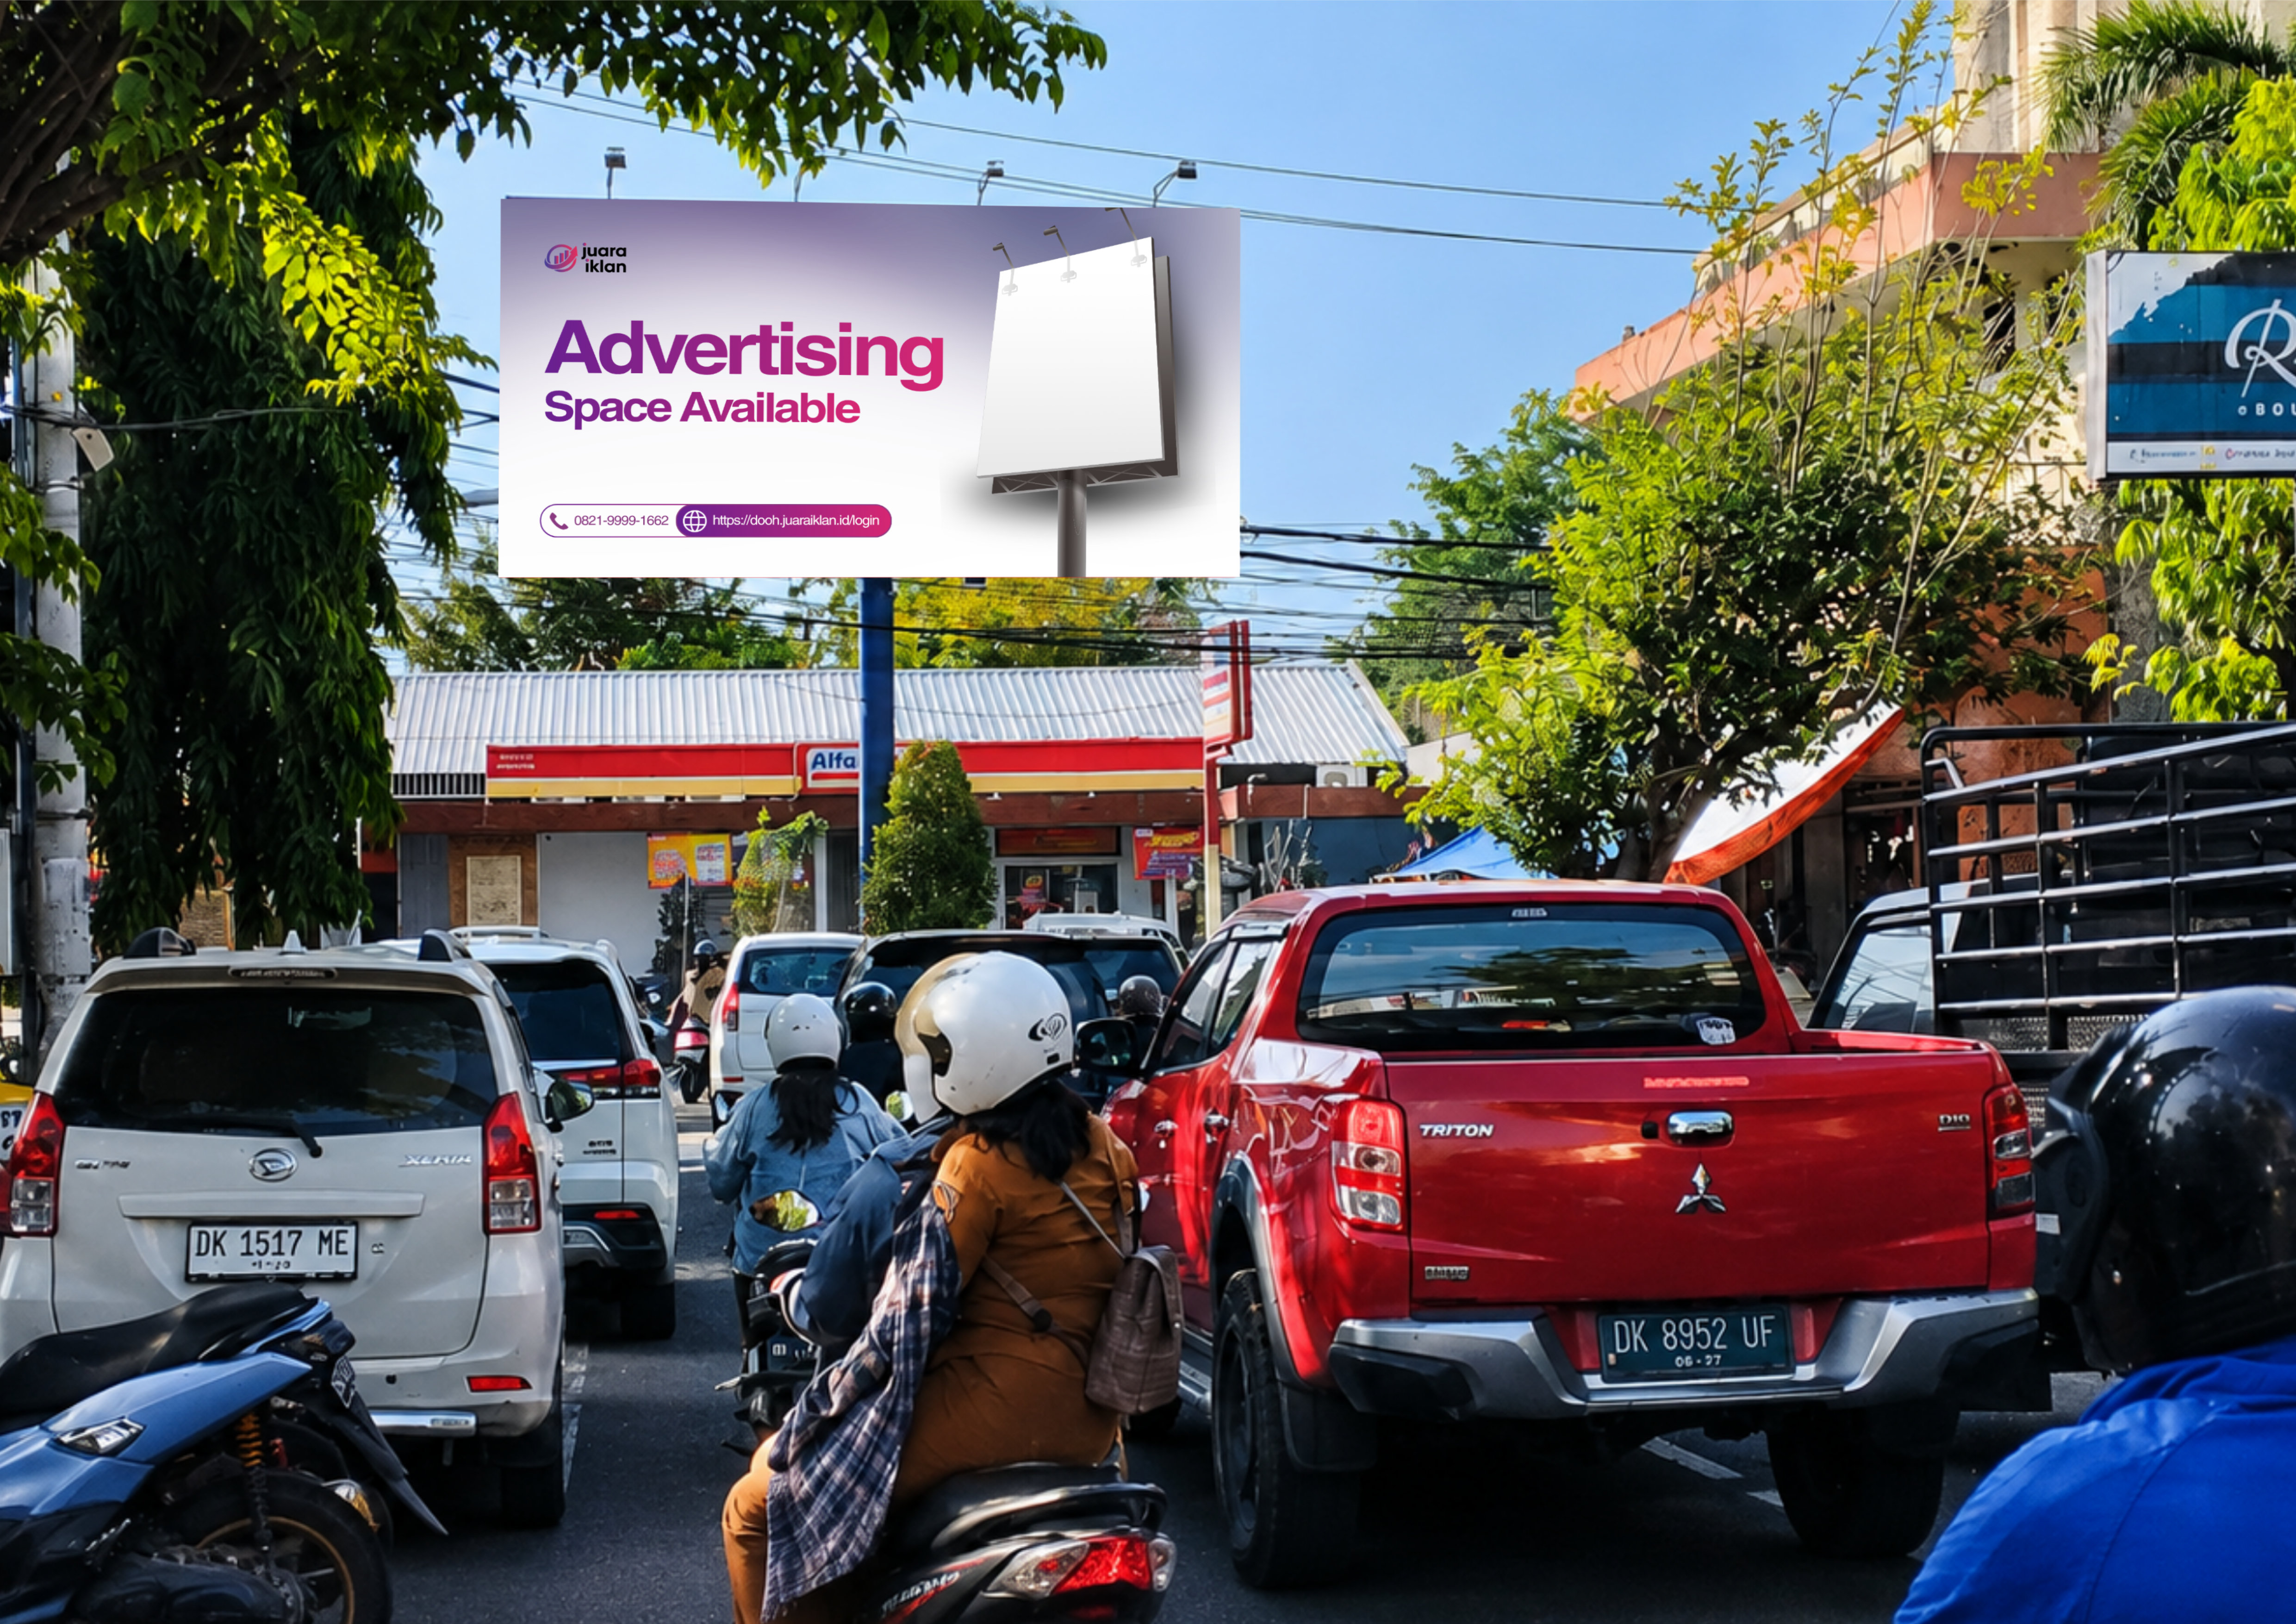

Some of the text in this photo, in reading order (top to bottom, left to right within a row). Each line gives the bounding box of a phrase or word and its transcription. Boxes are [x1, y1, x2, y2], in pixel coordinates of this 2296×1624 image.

[581, 243, 627, 260] juara
[585, 258, 627, 273] iklan
[544, 319, 944, 392] Advertising
[2224, 299, 2296, 398] R
[544, 390, 861, 430] Space Available
[574, 515, 880, 528] 0821-9999-1662 https://dooh.juaraiklan.id/login
[1419, 1124, 1494, 1137] TRITON
[195, 1230, 227, 1256] DK
[240, 1229, 303, 1256] 1517
[317, 1229, 348, 1255] ME
[1614, 1315, 1775, 1353] DK 8952 UF
